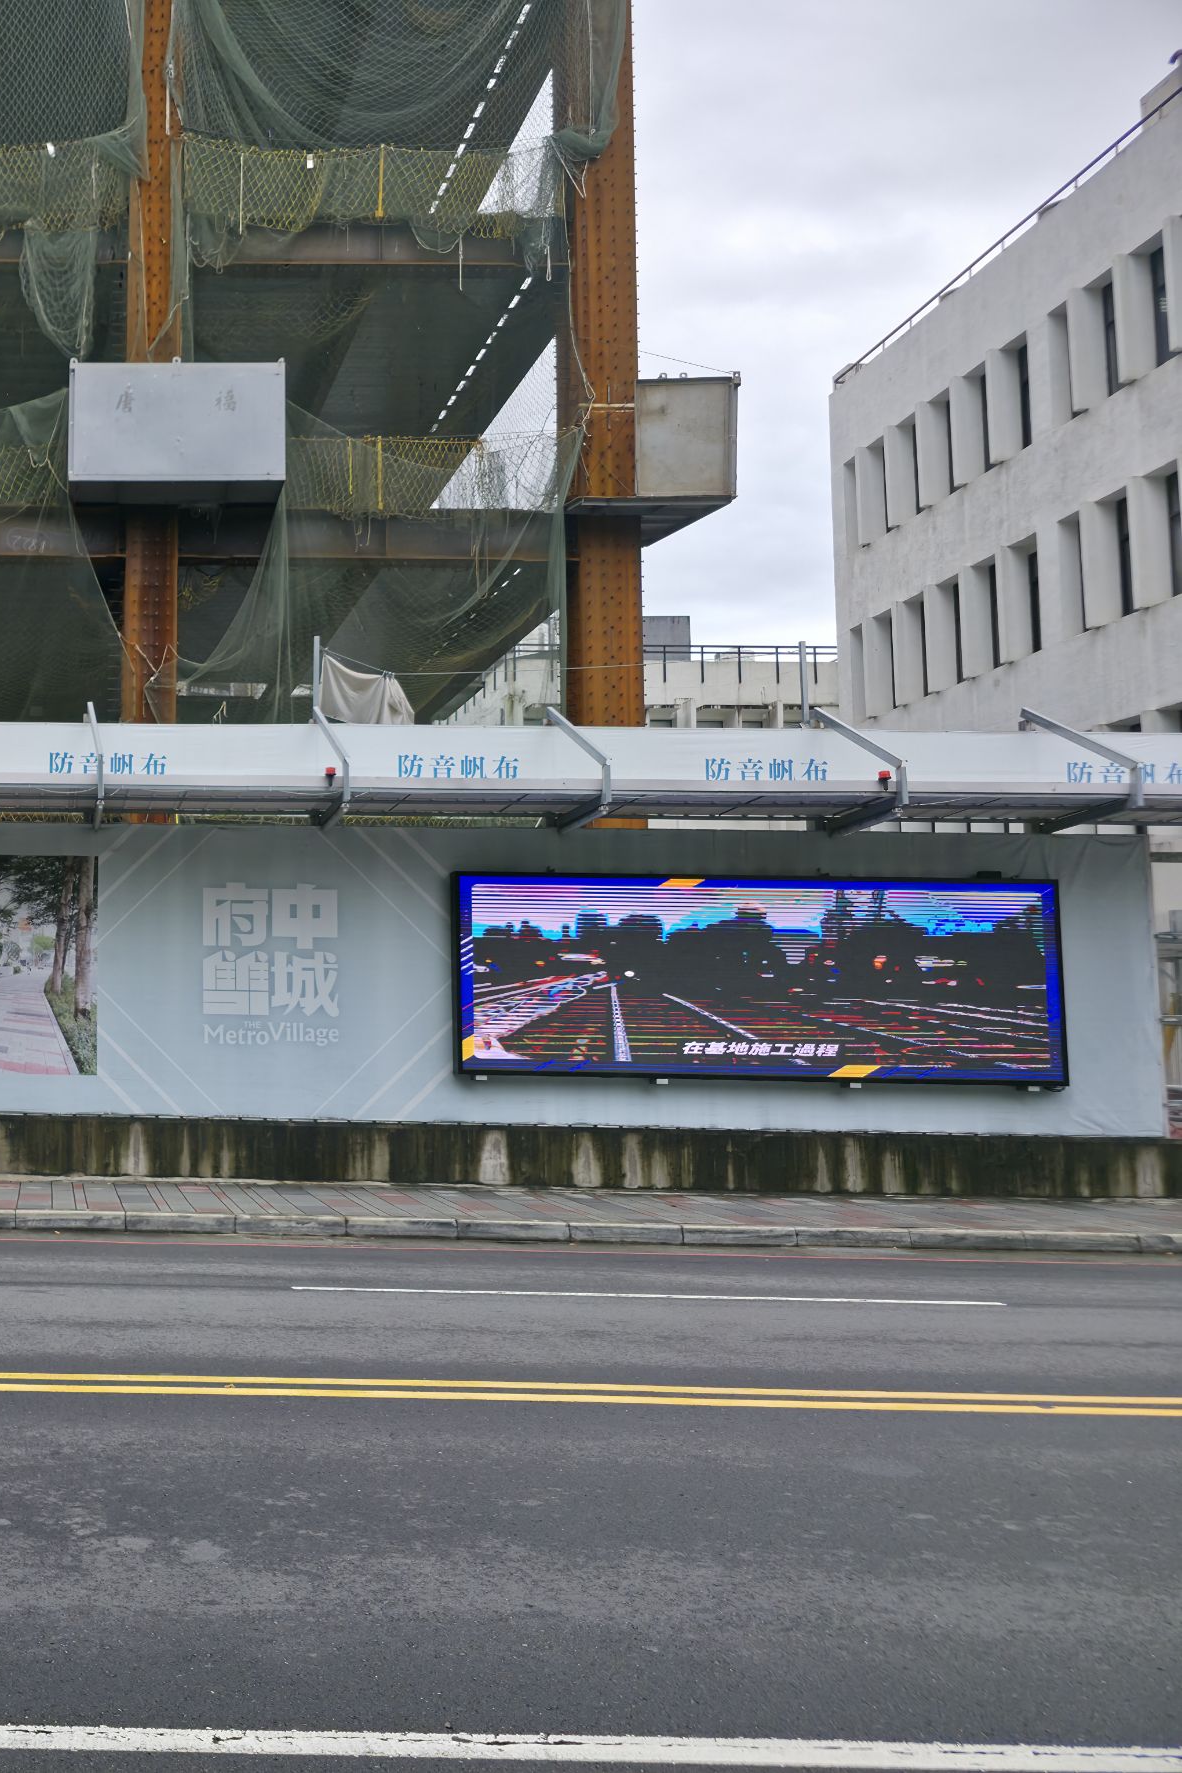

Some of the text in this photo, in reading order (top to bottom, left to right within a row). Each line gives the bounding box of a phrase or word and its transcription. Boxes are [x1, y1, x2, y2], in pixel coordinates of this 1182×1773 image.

[398, 755, 519, 779] 防音帆布
[705, 758, 828, 781] 防音帆布
[202, 882, 338, 949] 府中
[244, 1021, 261, 1029] THE
[682, 1041, 839, 1058] 在基地施工過程
